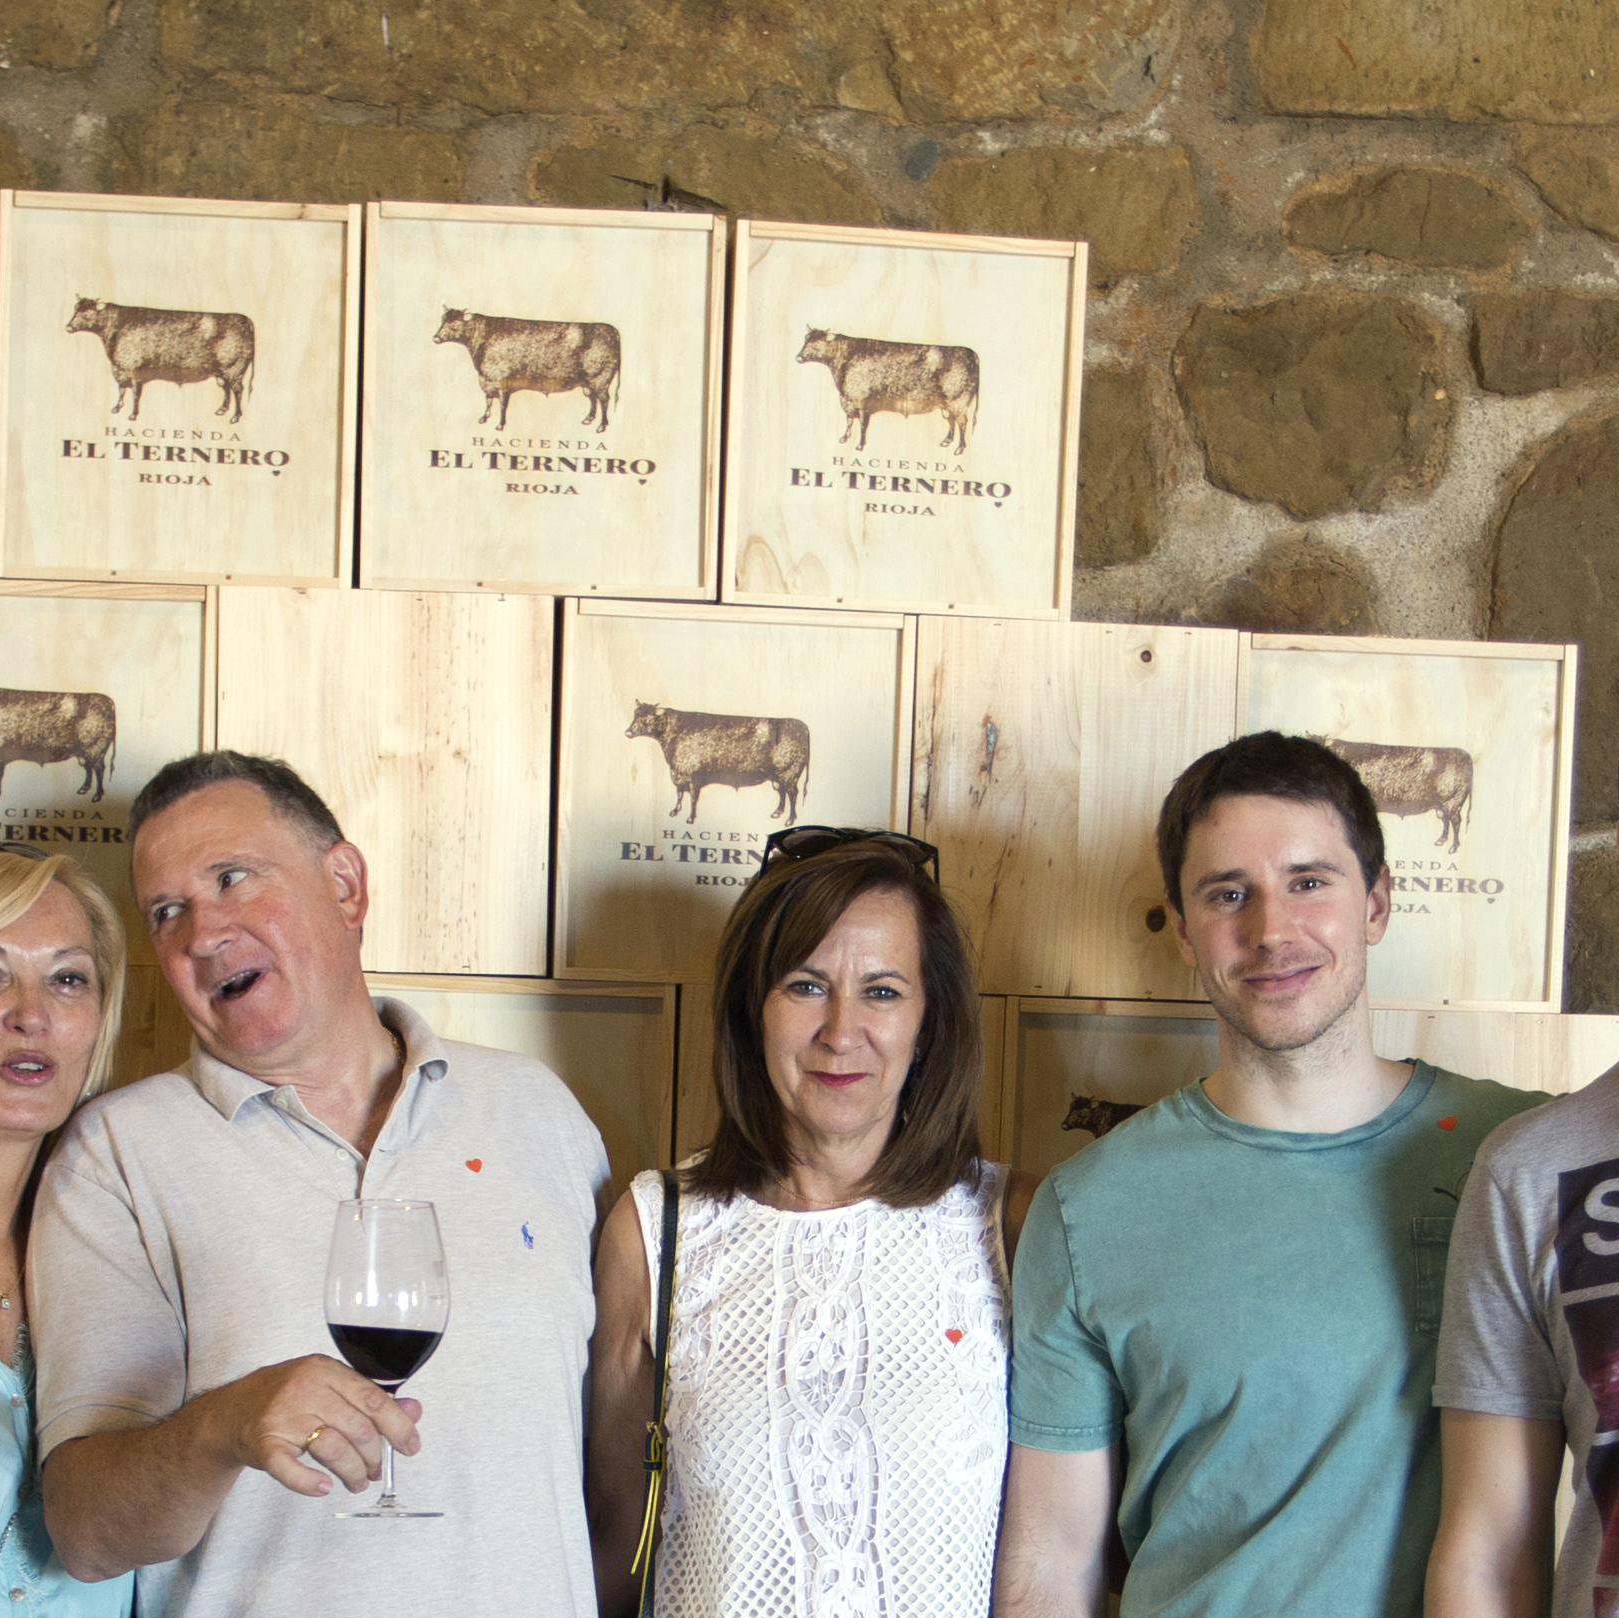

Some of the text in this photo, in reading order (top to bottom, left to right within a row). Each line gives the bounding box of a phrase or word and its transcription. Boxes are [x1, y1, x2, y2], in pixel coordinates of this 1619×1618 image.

[103, 426, 242, 443] HACIENDA
[471, 436, 609, 451] HACIENDA
[61, 438, 291, 468] EL TERNERO
[429, 449, 657, 476] EL TERNERO
[831, 455, 965, 474] HACIENDA
[138, 473, 213, 487] RIOJA
[505, 482, 580, 495] RIOJA
[789, 466, 1012, 499] EL TERNERO
[863, 502, 937, 517] RIOJA
[662, 829, 768, 843] HACIEN
[619, 841, 765, 866] EL TERN
[694, 874, 750, 888] RIOJ
[1389, 875, 1505, 895] RNERO
